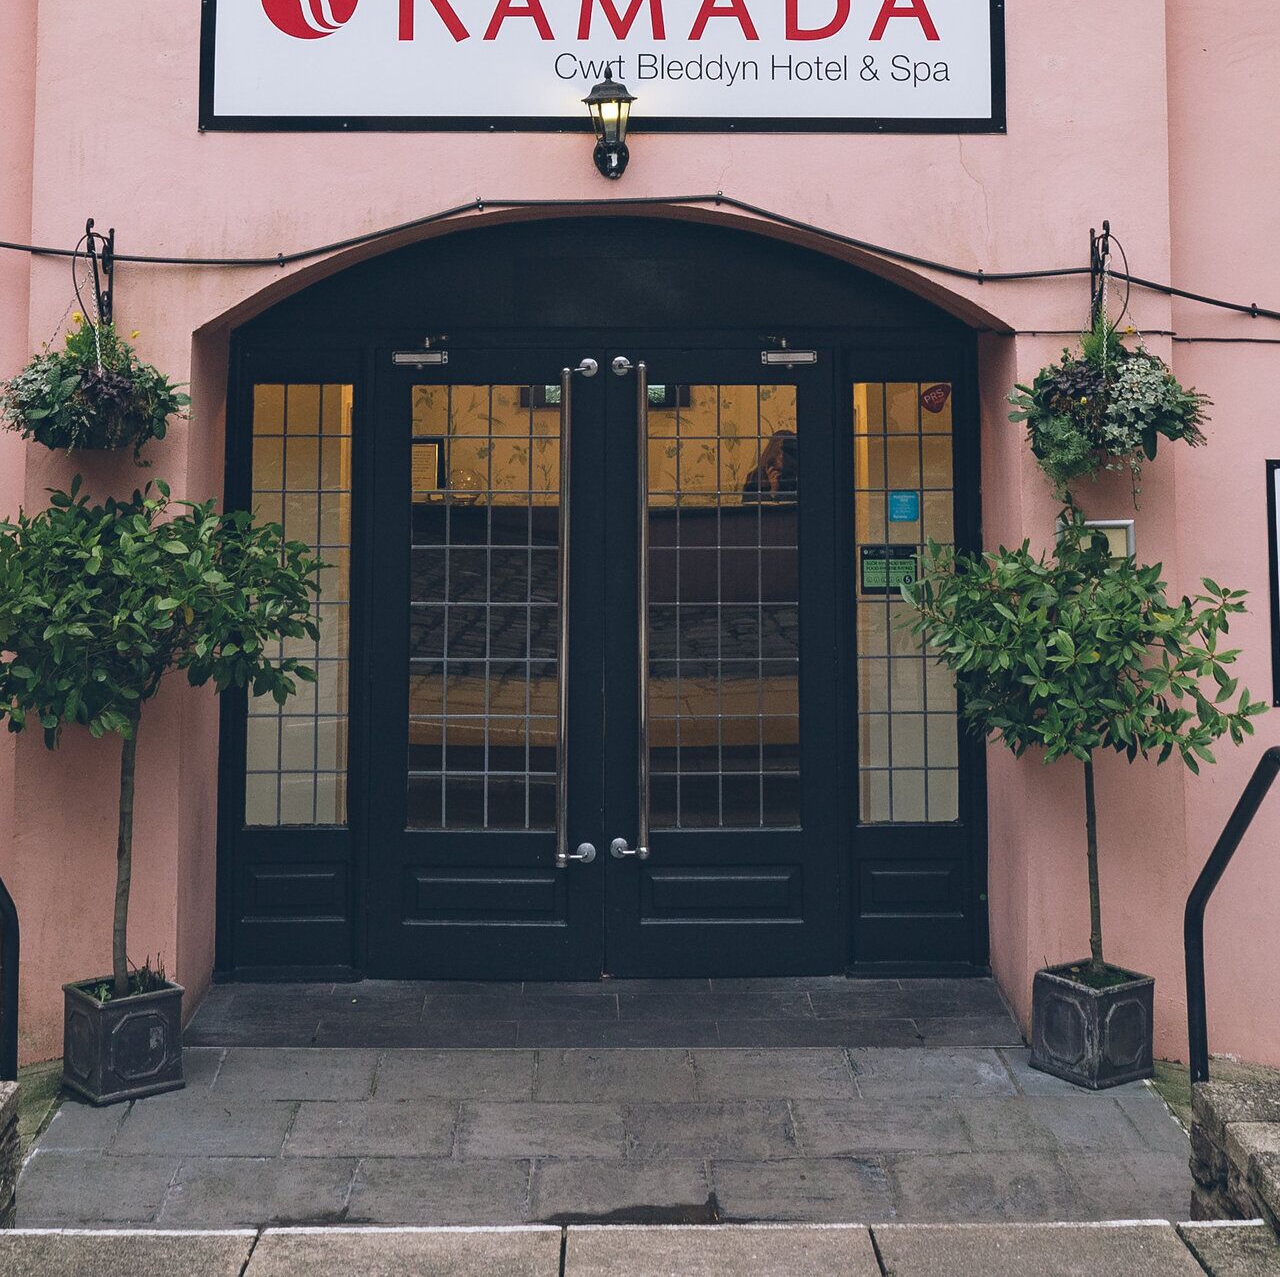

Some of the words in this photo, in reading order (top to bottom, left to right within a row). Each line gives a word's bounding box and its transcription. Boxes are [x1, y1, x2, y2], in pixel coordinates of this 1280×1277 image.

[637, 53, 758, 86] Bleddyn
[771, 54, 847, 81] Hotel
[859, 54, 882, 81] &
[890, 54, 951, 87] Spa
[923, 388, 944, 404] PRS
